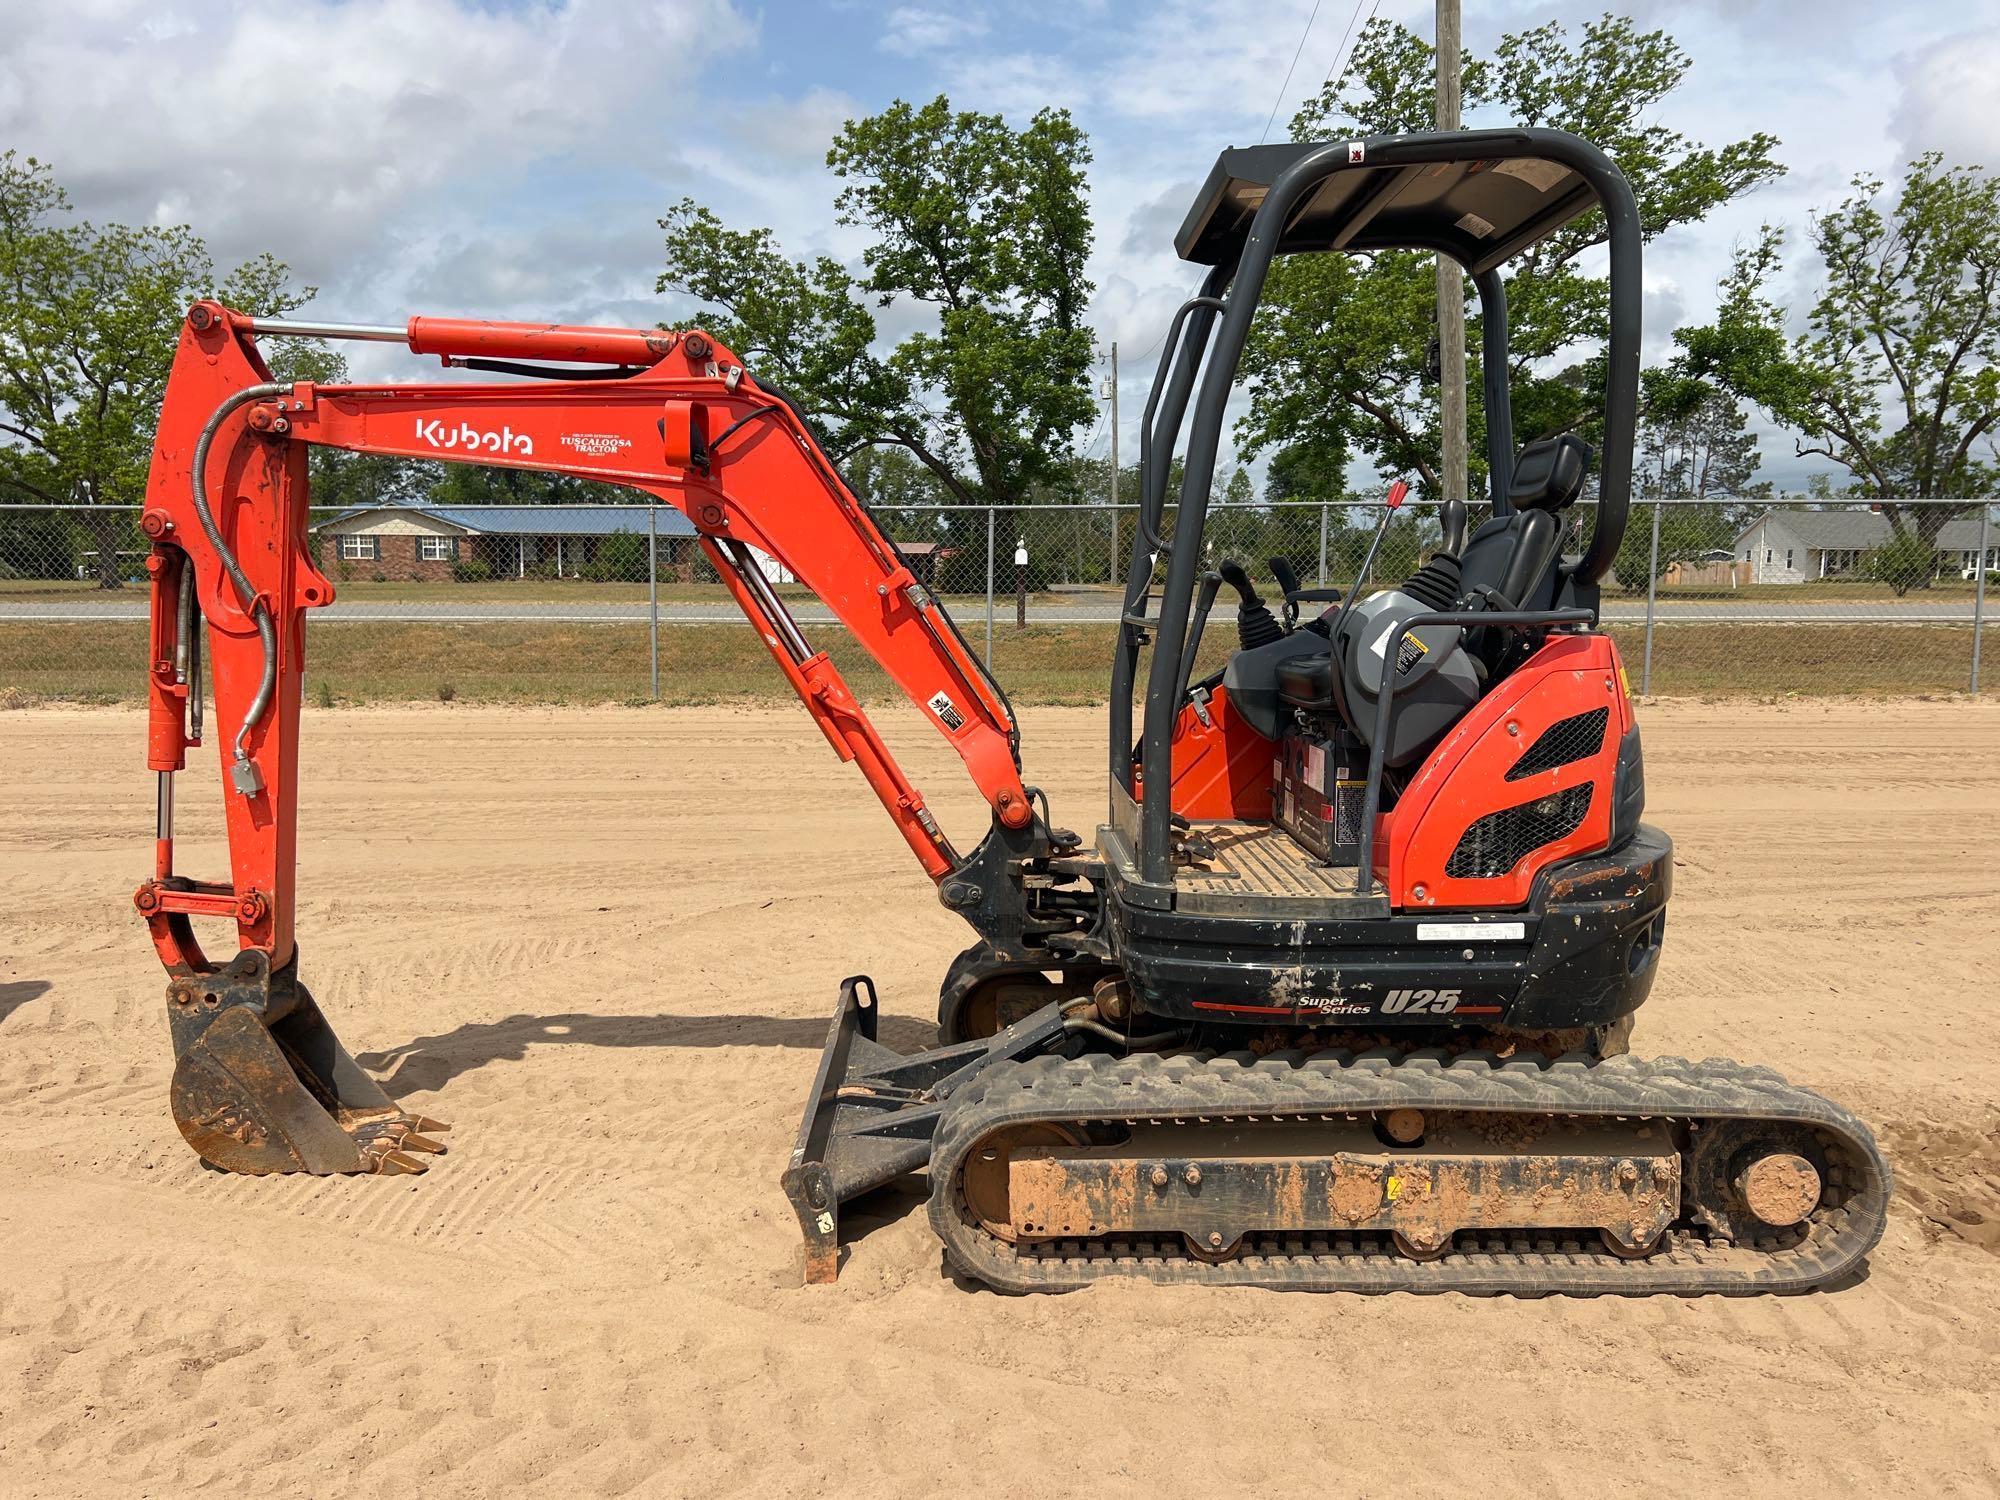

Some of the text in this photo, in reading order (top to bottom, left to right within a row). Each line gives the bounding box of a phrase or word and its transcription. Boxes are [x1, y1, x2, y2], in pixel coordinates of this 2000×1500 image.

[416, 418, 533, 455] Kubota
[560, 437, 632, 447] TUSCALOOSA
[575, 445, 618, 453] TRACTOR
[1298, 996, 1347, 1007] Super
[1380, 989, 1462, 1014] U25
[1320, 1004, 1371, 1014] Series
